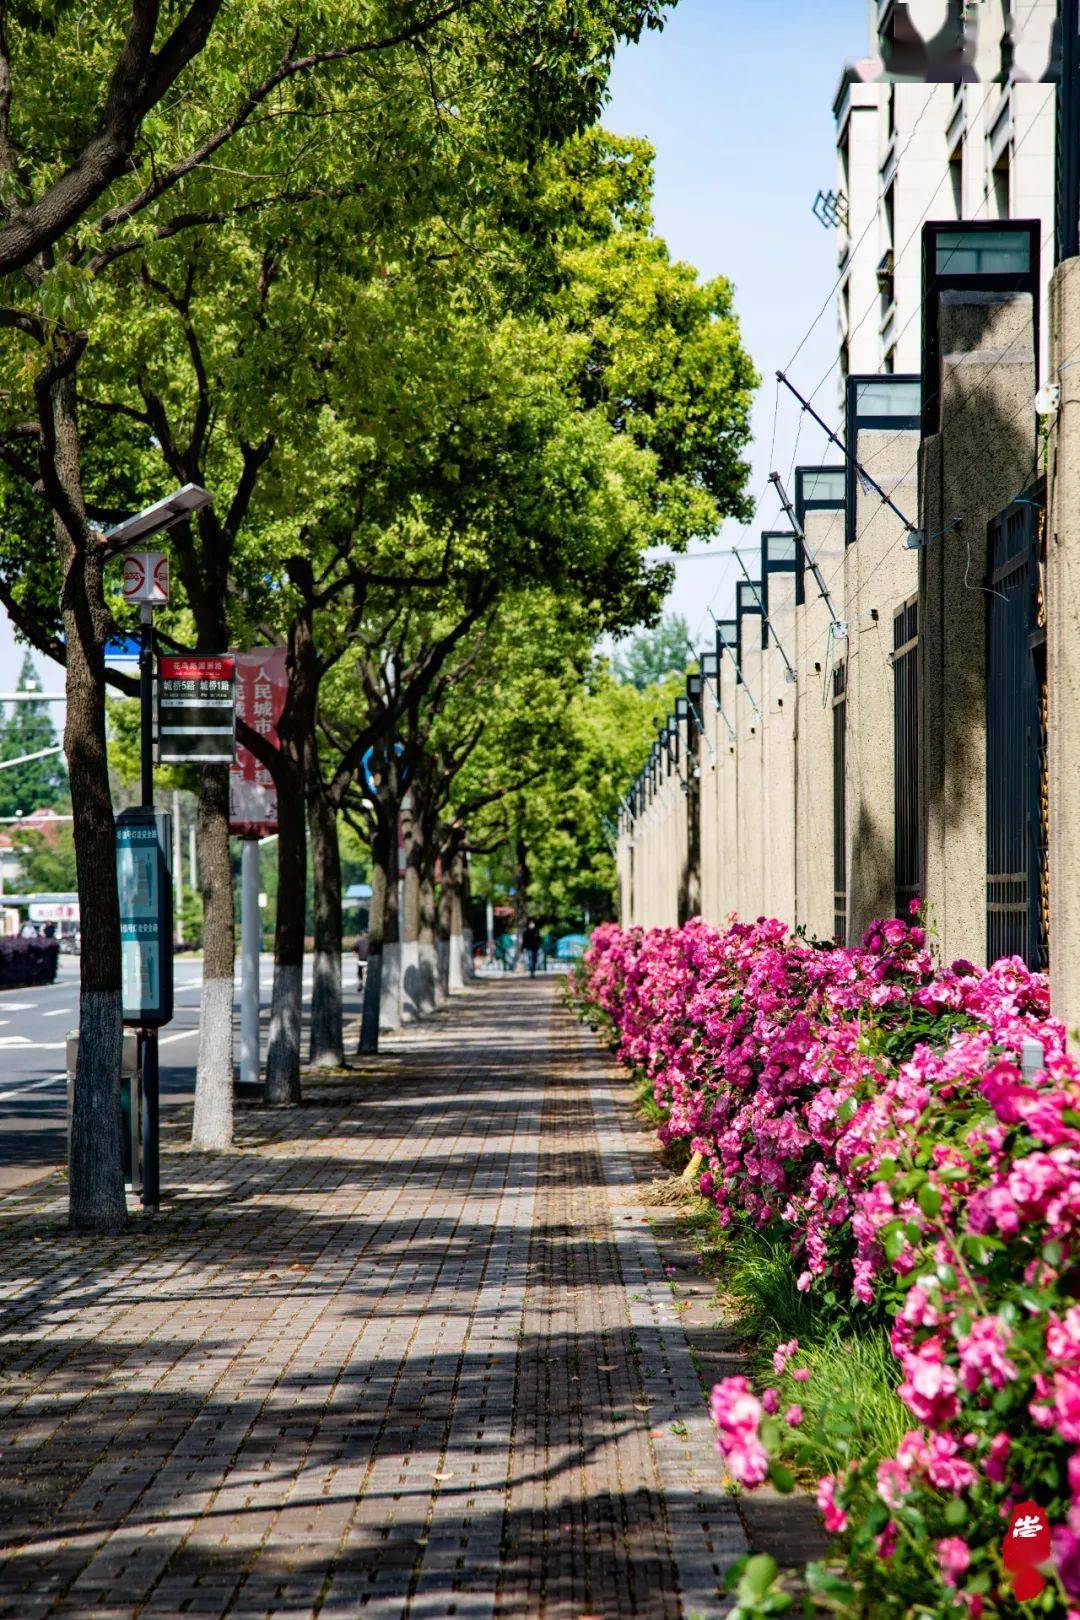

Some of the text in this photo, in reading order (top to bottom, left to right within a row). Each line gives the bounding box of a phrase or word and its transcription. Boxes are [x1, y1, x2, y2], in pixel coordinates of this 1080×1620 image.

[163, 680, 195, 691] 城桥5路
[200, 680, 229, 691] 城桥1路
